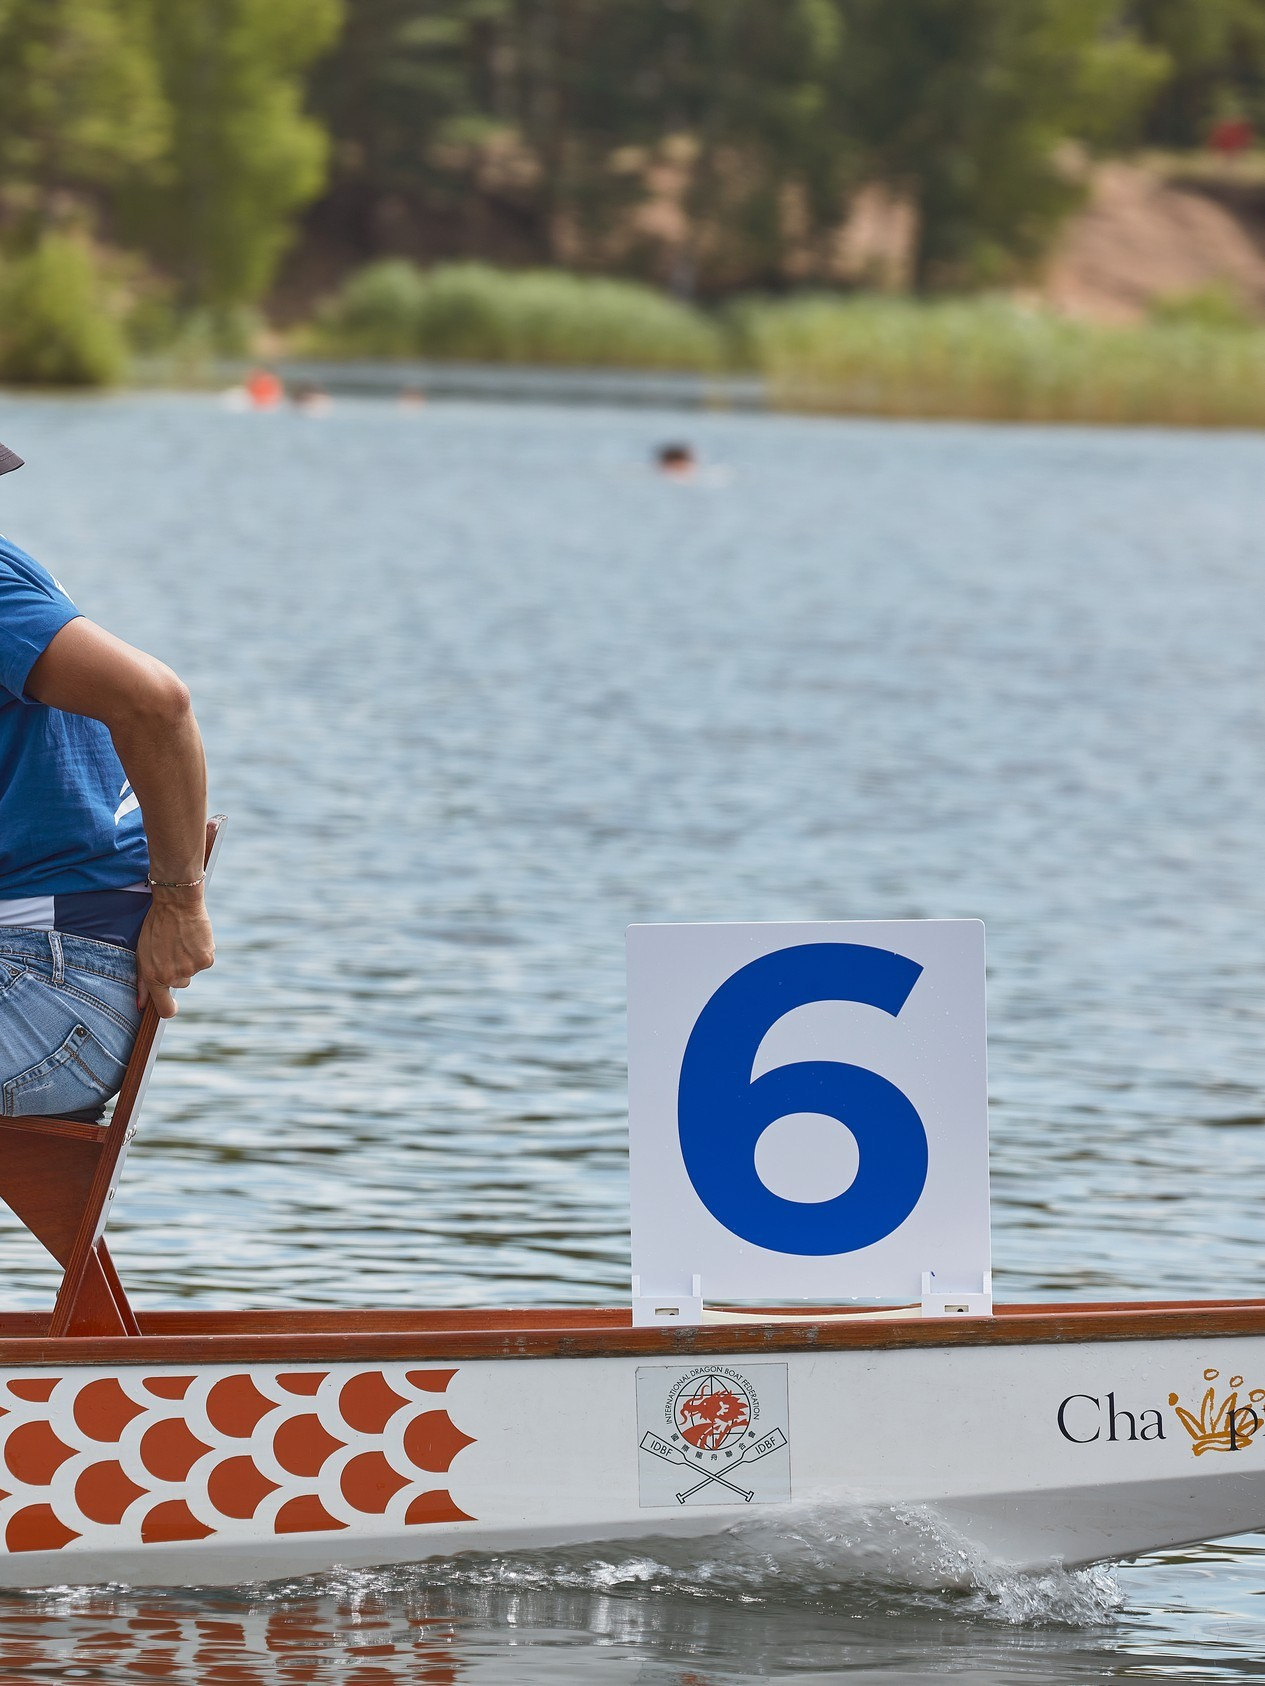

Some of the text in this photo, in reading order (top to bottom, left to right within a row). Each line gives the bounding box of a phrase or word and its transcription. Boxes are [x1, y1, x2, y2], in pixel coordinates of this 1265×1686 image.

[678, 943, 928, 1256] 6
[664, 1365, 760, 1424] INTERNATIONAL DRAGON BOAT FEDERATION
[650, 1440, 673, 1457] IDBF
[754, 1436, 776, 1455] IDBF
